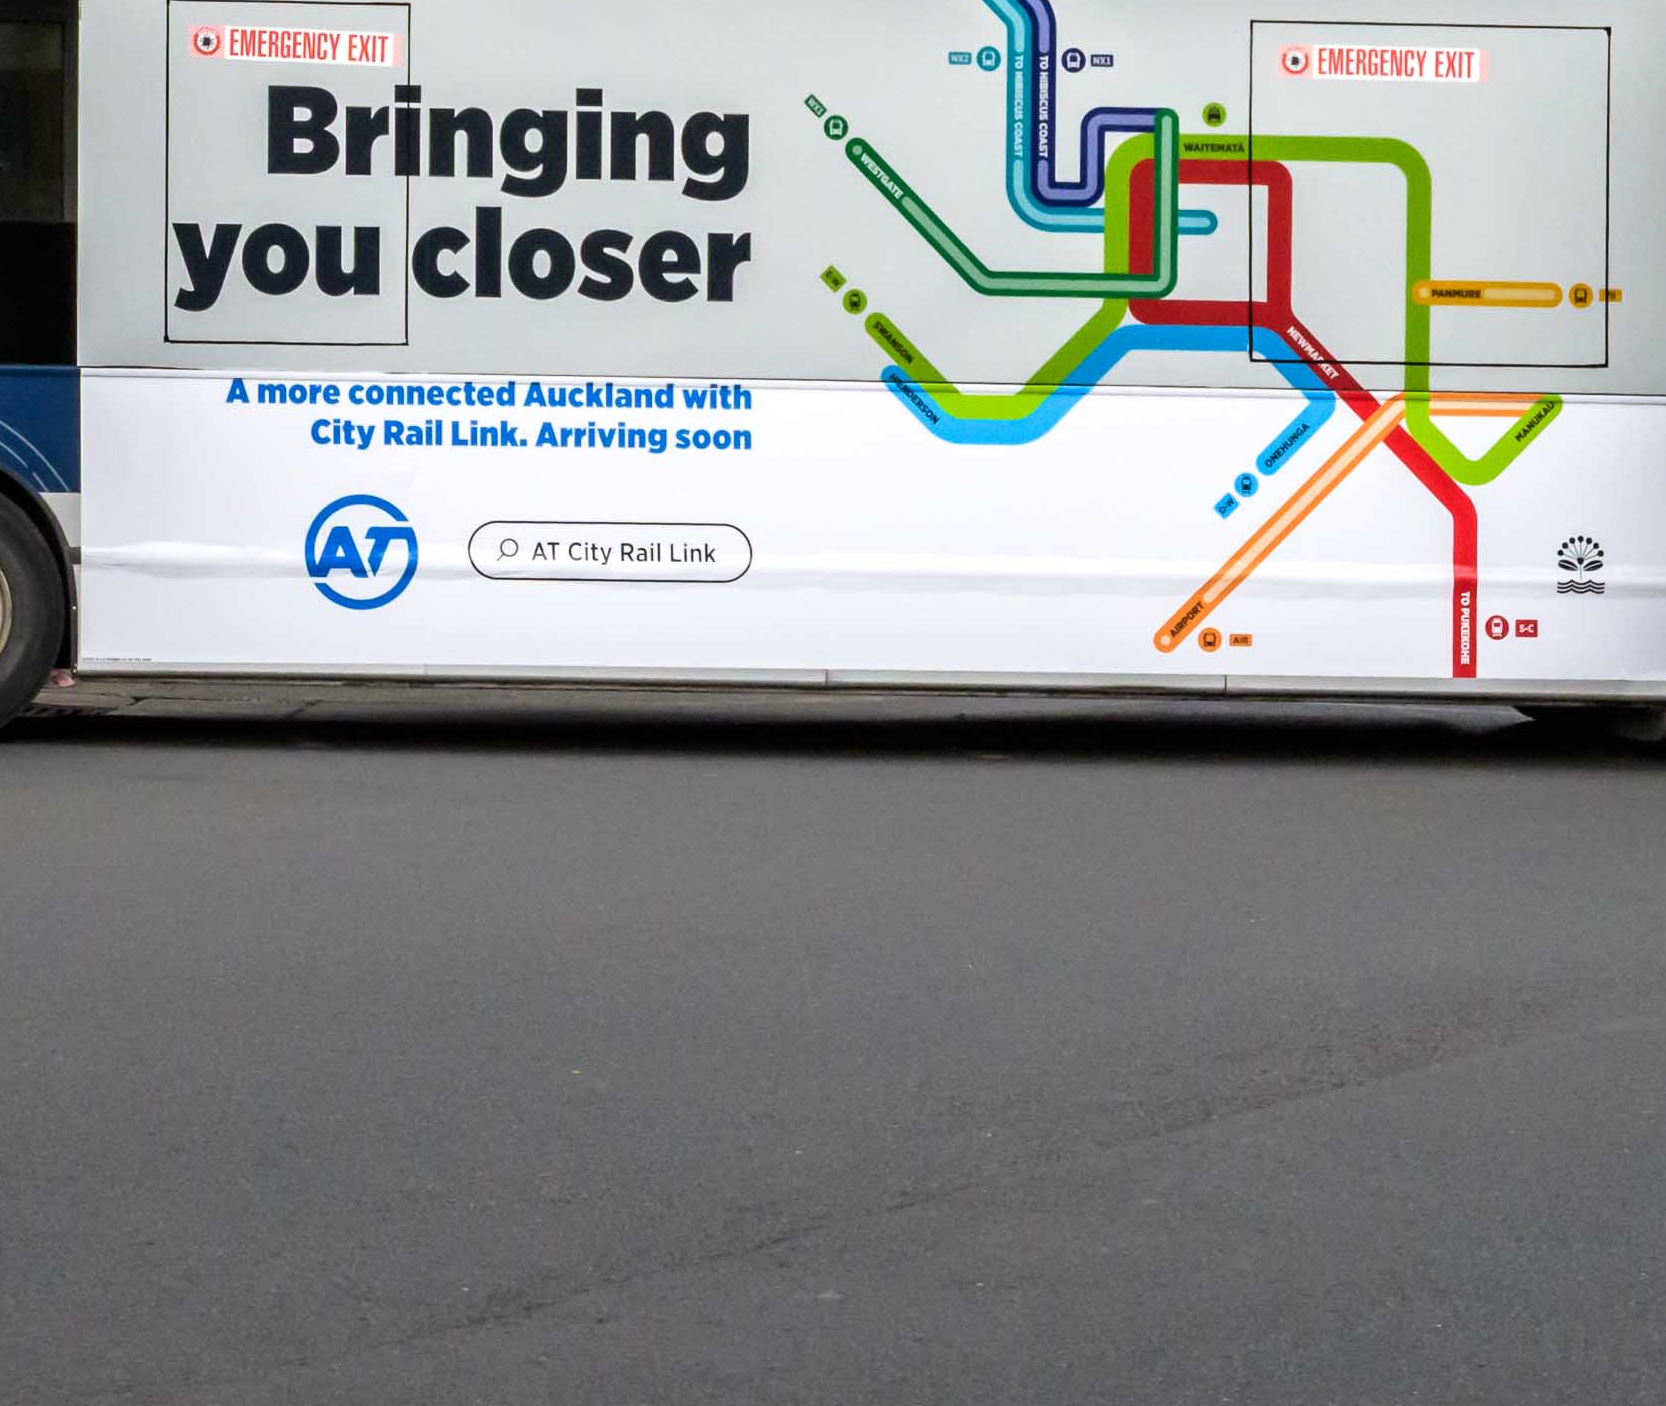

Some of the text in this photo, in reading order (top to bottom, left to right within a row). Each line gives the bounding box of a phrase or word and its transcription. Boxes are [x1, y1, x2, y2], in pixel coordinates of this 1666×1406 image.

[230, 28, 389, 63] EMERGENCY EXIT
[1013, 53, 1024, 69] TO
[1318, 47, 1475, 78] EMERGENCY EXIT
[1037, 55, 1050, 158] TO HIBISCUS COAST
[267, 84, 749, 201] Bringing
[1013, 121, 1024, 157] COAST
[859, 151, 904, 200] WESTGATE
[172, 206, 751, 312] you closer
[1431, 289, 1481, 298] PANMURE
[873, 321, 915, 365] SWANSON
[226, 378, 753, 410] A more connected Auckland with
[889, 372, 941, 425] HENDERSON
[311, 418, 753, 454] City Rail Link. Arriving soon
[1514, 400, 1556, 443] MANUKAU
[1264, 423, 1310, 468] ONEHUNGA
[532, 542, 716, 566] AT City Rail Link
[1170, 601, 1205, 639] AIRPORT
[1460, 591, 1471, 665] TO PUKEKOHE
